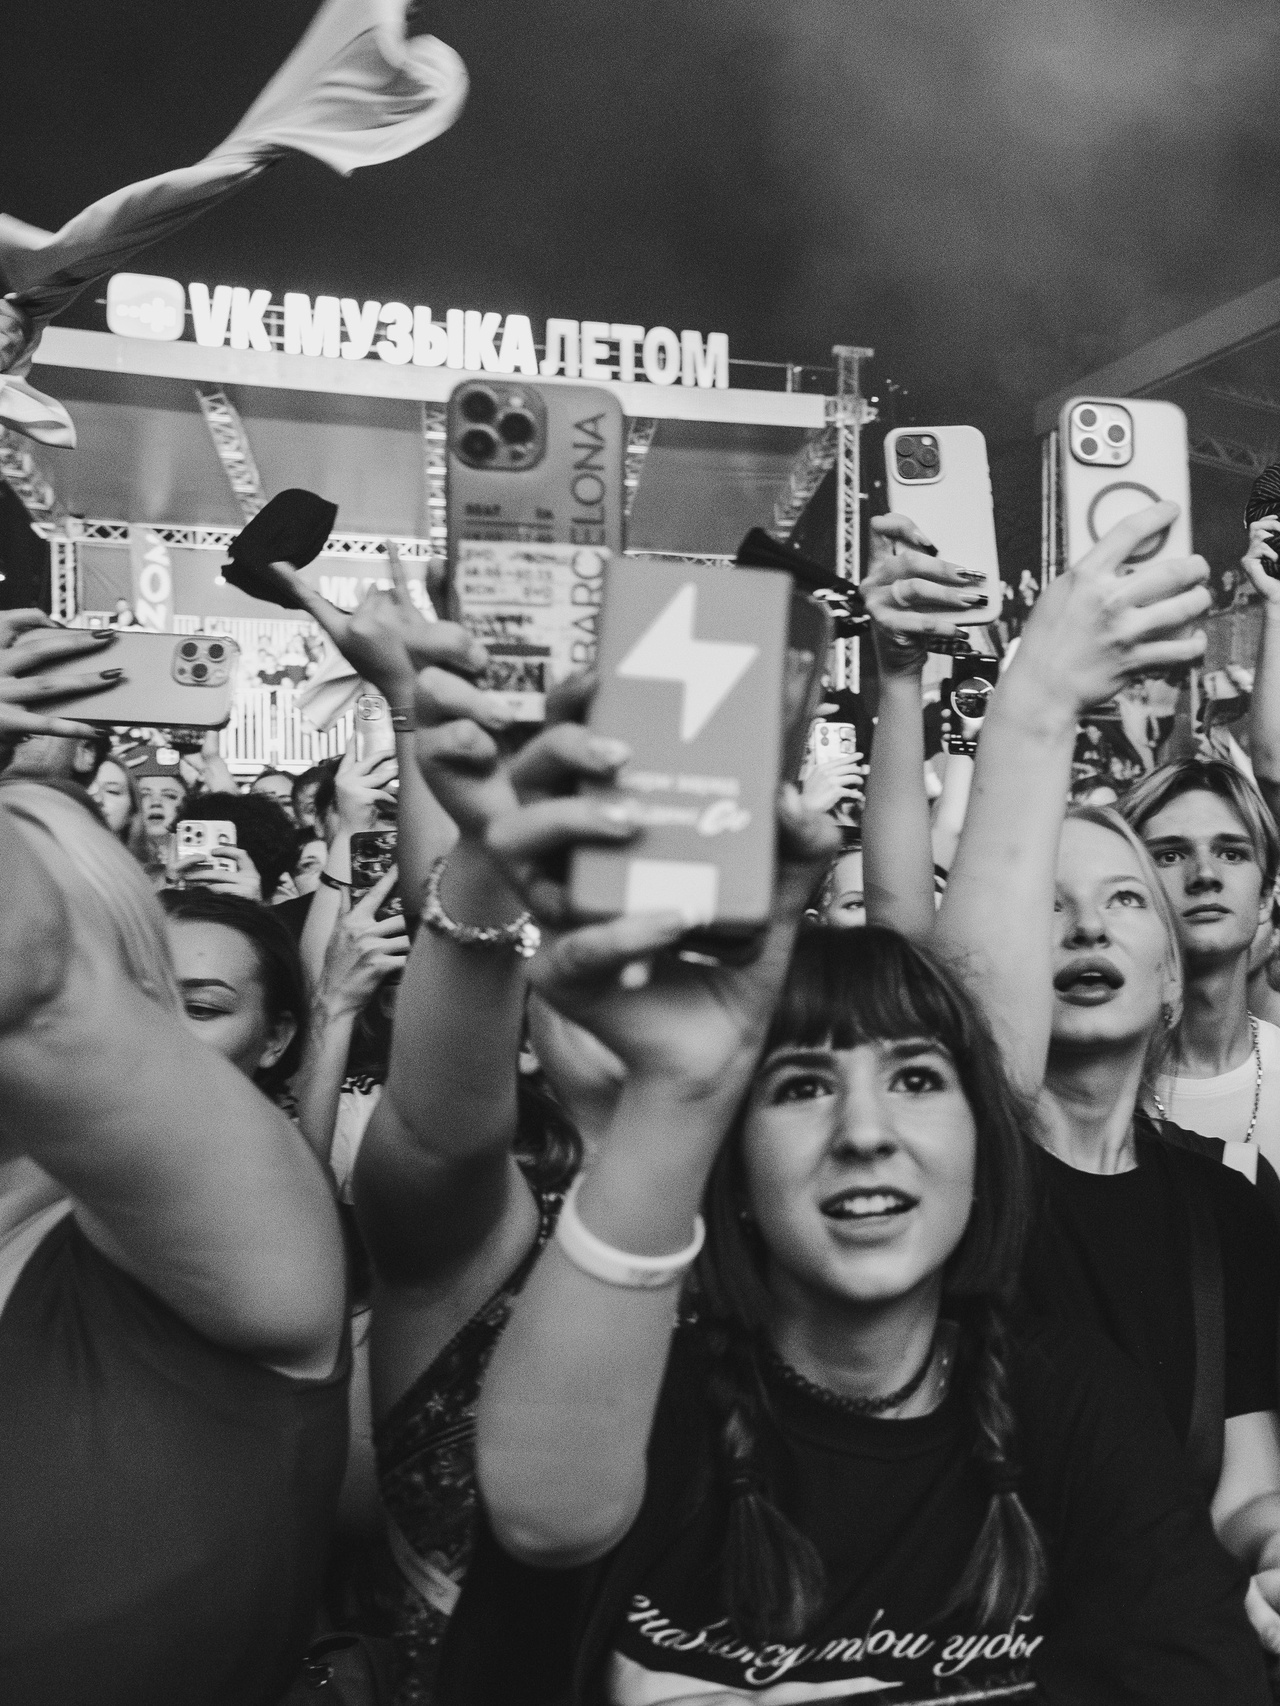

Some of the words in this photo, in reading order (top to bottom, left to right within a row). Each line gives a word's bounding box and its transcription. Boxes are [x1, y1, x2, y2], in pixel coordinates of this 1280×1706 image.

[188, 282, 272, 352] VK
[283, 293, 538, 376] МУЗЫКА
[540, 318, 729, 389] ЛЕТОМ
[135, 533, 172, 632] ZON
[570, 412, 606, 664] BARCELONA
[815, 1609, 935, 1662] твои
[932, 1613, 1044, 1677] губы
